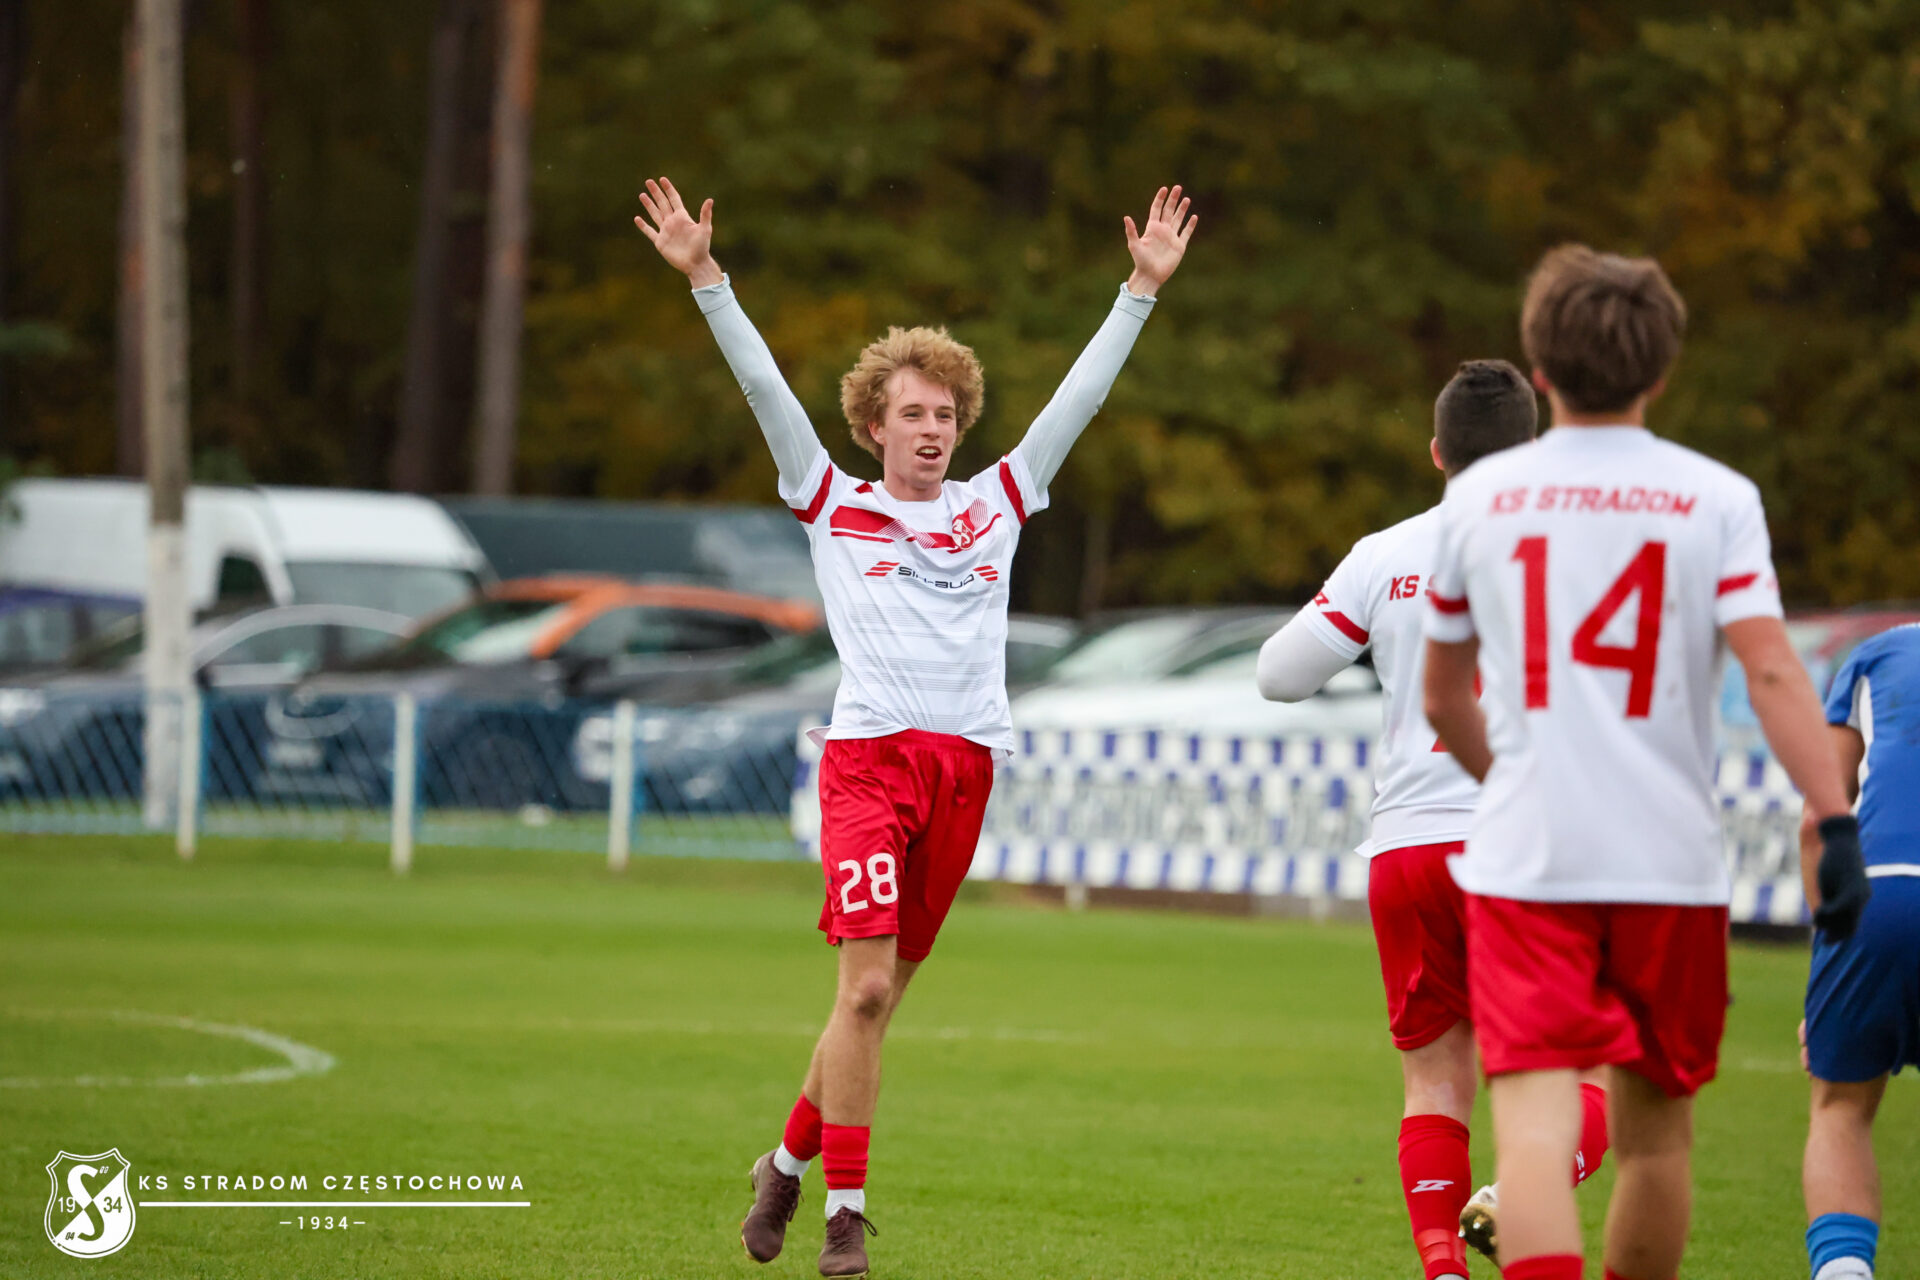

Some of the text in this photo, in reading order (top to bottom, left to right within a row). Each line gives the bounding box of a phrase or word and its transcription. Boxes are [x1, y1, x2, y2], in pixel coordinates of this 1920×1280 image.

[1490, 486, 1697, 517] KS STRADOM
[1388, 574, 1421, 601] KS
[1511, 535, 1667, 719] 14
[838, 852, 899, 914] 28
